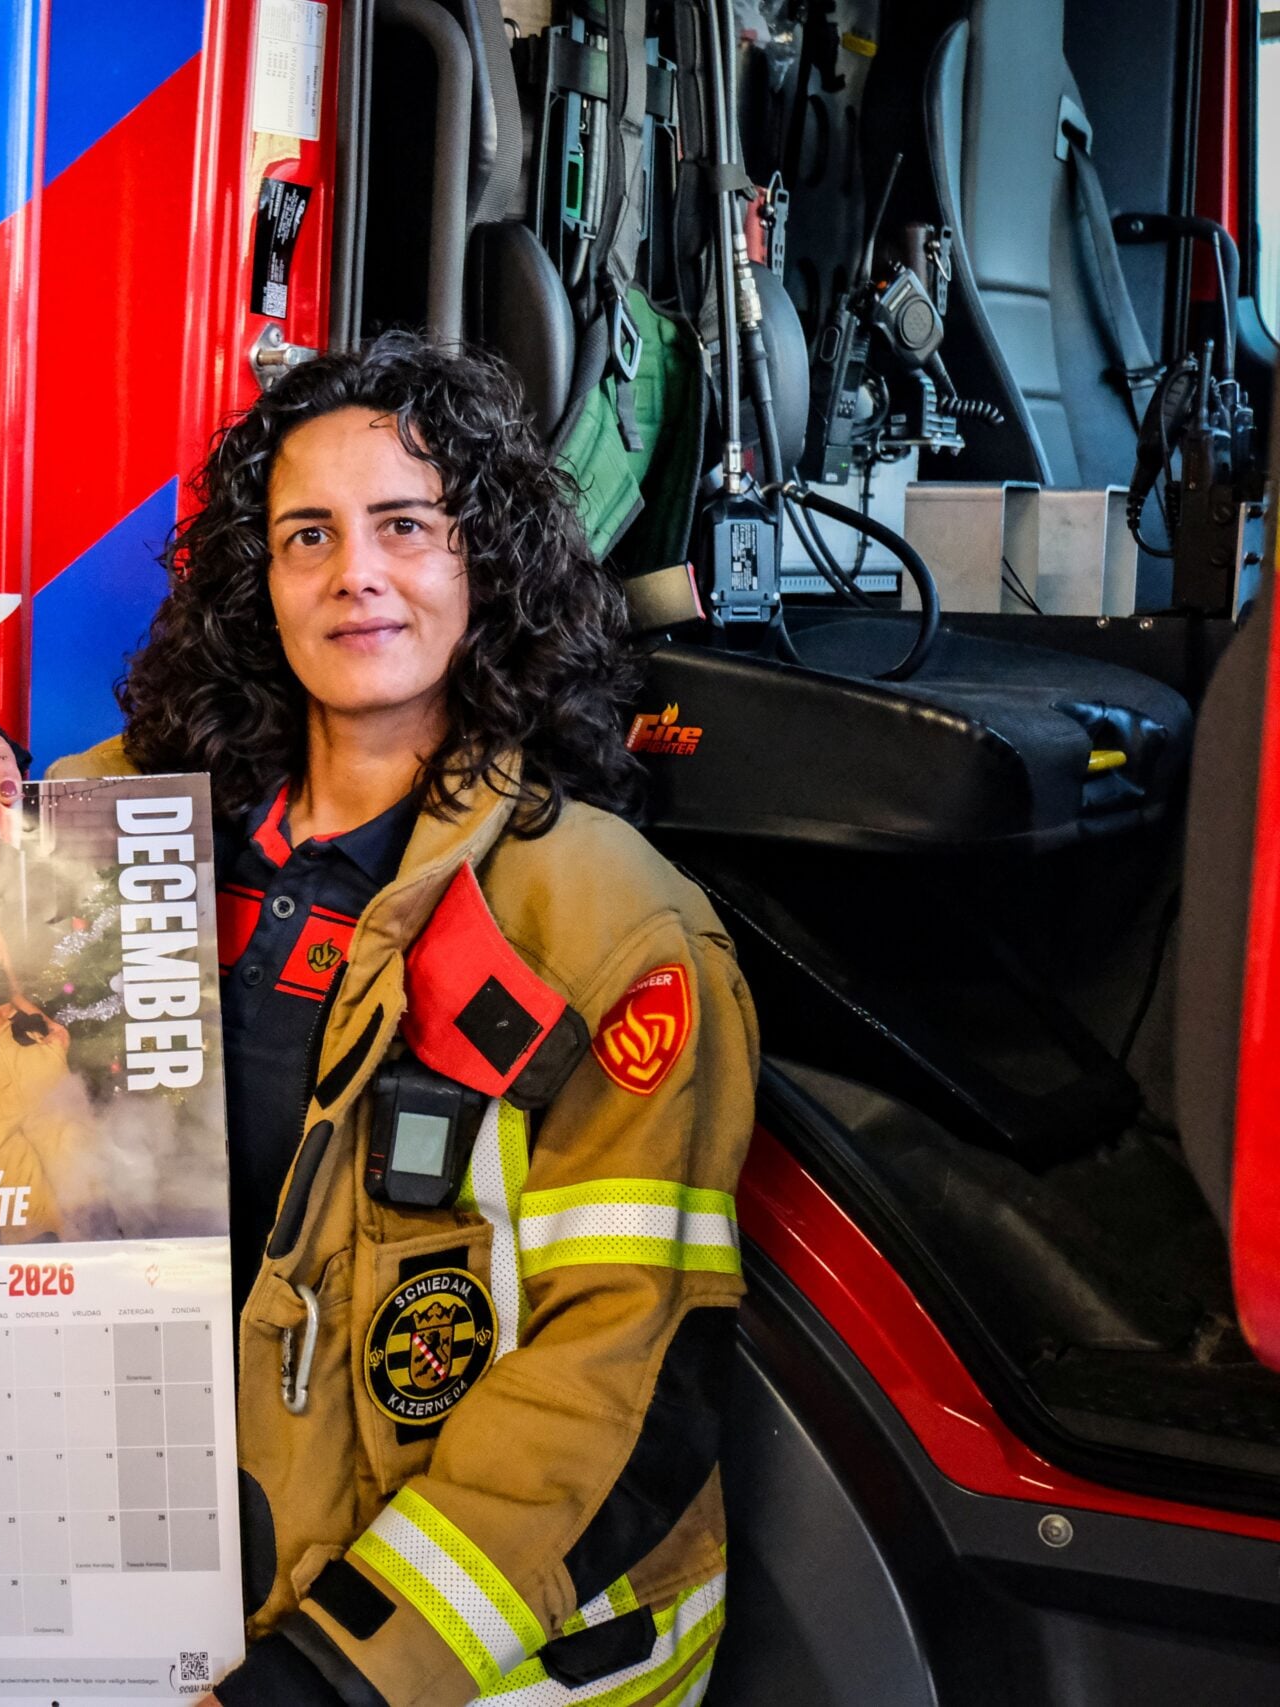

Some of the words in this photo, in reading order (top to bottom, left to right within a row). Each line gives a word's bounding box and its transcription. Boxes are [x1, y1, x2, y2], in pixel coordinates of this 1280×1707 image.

[116, 796, 204, 1091] DECEMBER
[394, 1276, 473, 1309] SCHIEDAM
[15, 1311, 59, 1319] DONDERDAG
[72, 1309, 102, 1317] VRIJDAG
[118, 1308, 155, 1316] ZATERDAG
[171, 1306, 201, 1314] ZONDAG
